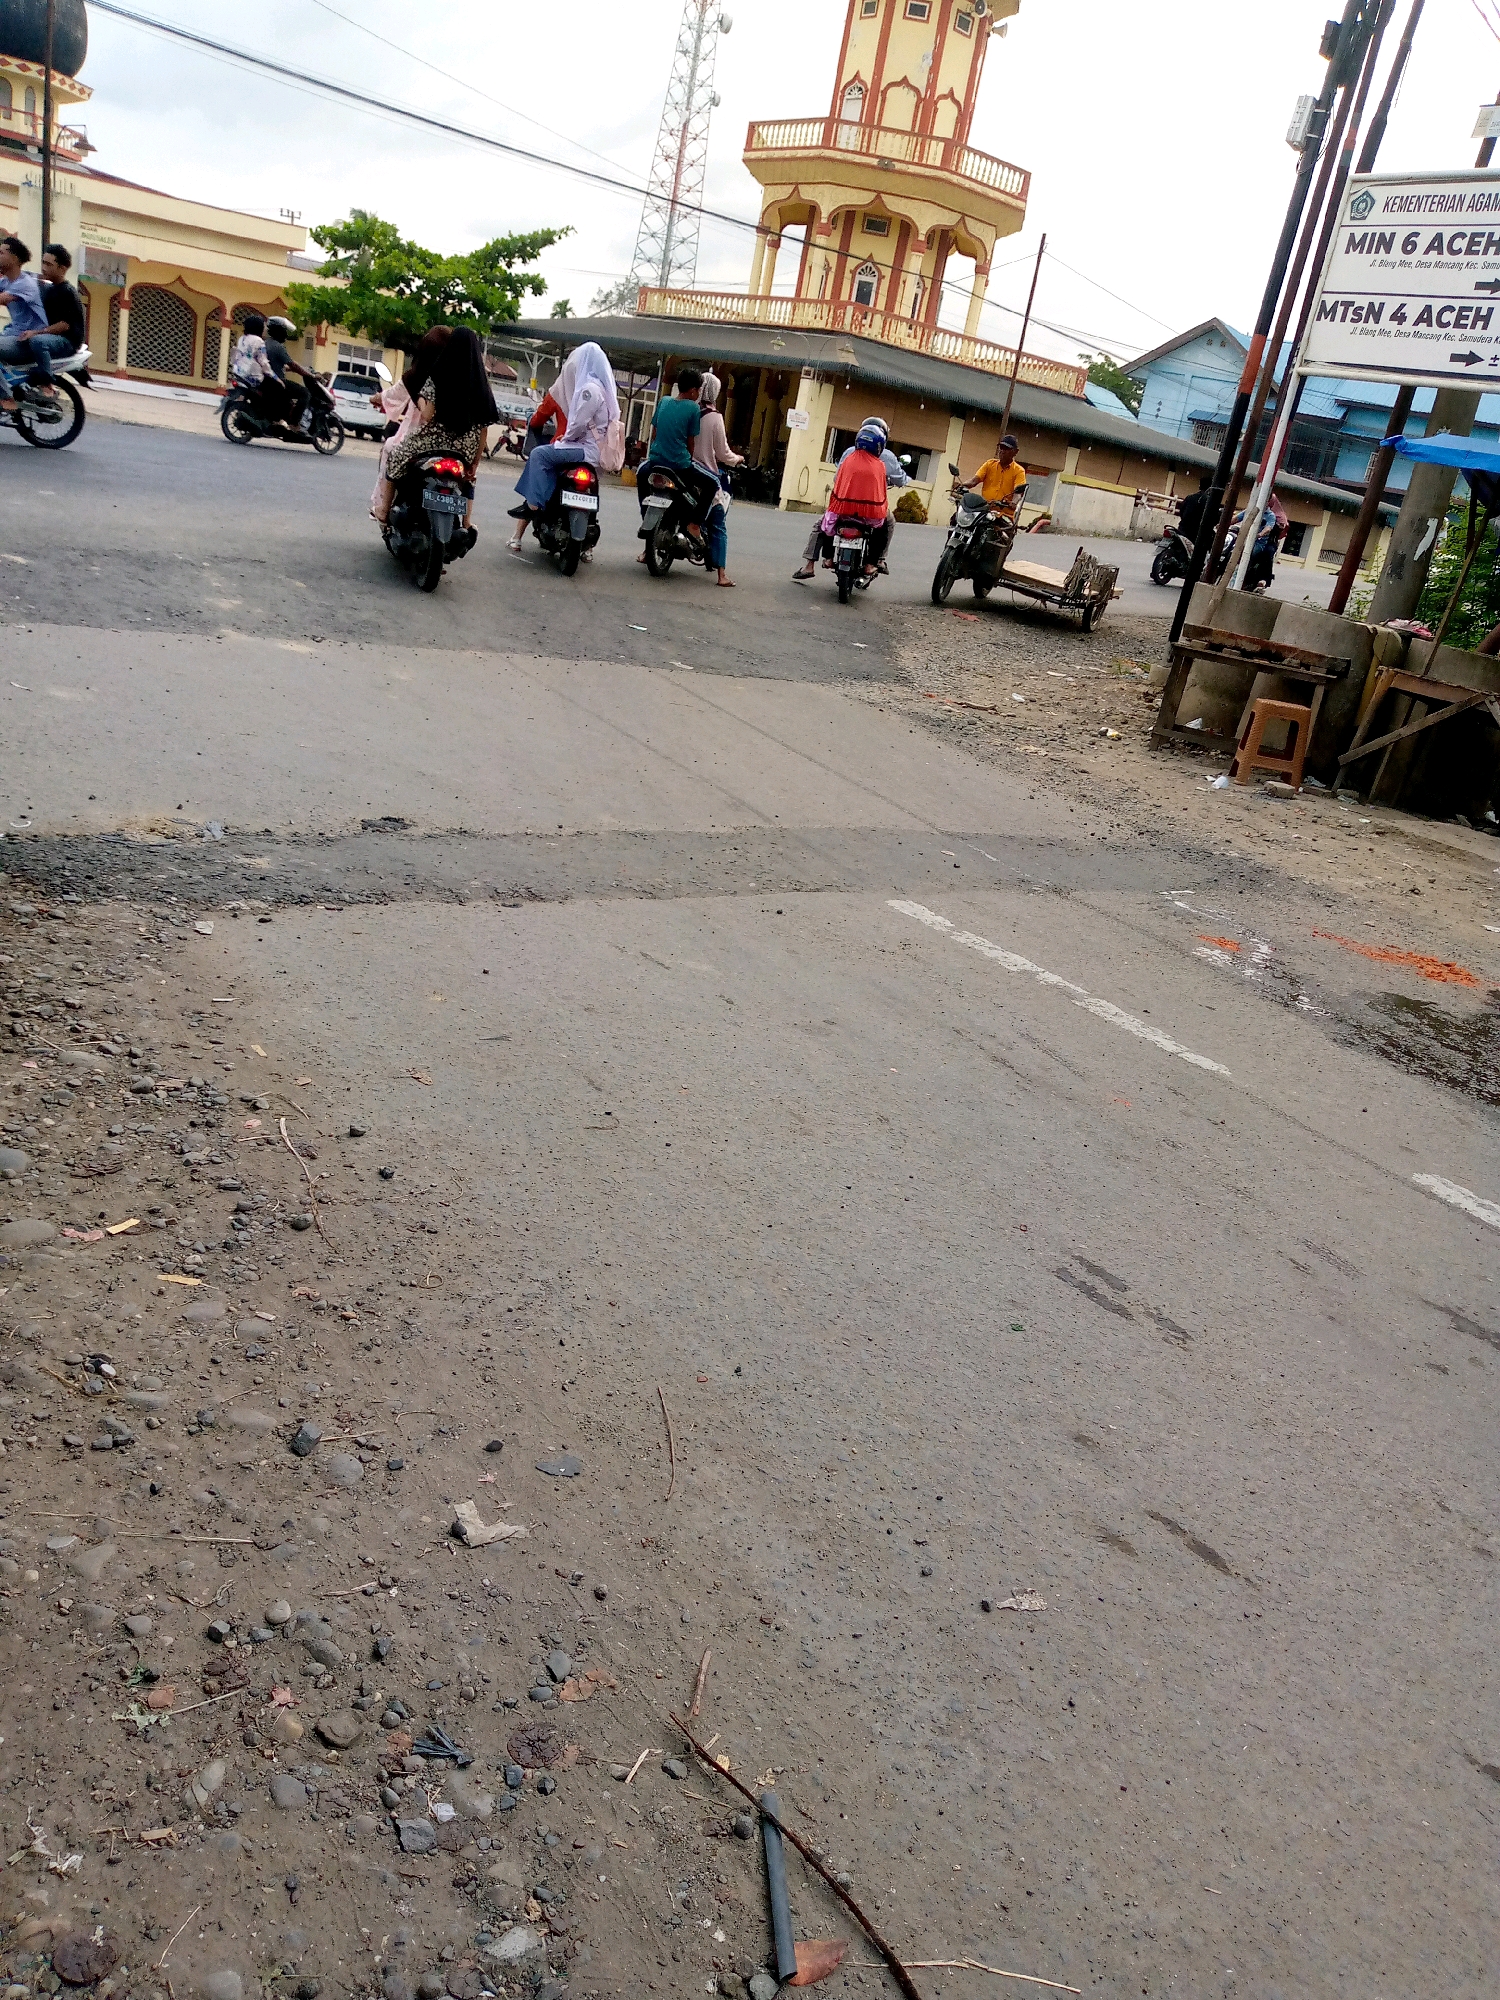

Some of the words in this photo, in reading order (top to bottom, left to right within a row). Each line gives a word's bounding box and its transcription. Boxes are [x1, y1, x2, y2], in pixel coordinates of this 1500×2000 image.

[1382, 194, 1466, 213] KEMENTERIAN
[1344, 231, 1396, 255] MIN
[1401, 231, 1421, 255] 6
[1422, 231, 1500, 256] ACEH
[1398, 259, 1413, 269] Mee,
[1414, 260, 1433, 269] Desa
[1464, 260, 1479, 270] Kec.
[1315, 300, 1385, 324] MTsN
[1389, 303, 1407, 325] 4
[1412, 304, 1495, 331] ACEH
[1358, 327, 1377, 338] Blang
[1376, 327, 1392, 339] Mee,
[1394, 329, 1412, 339] Desa
[1411, 330, 1442, 343] Mancang
[1441, 332, 1456, 342] Kec.
[1458, 333, 1493, 344] Samudera
